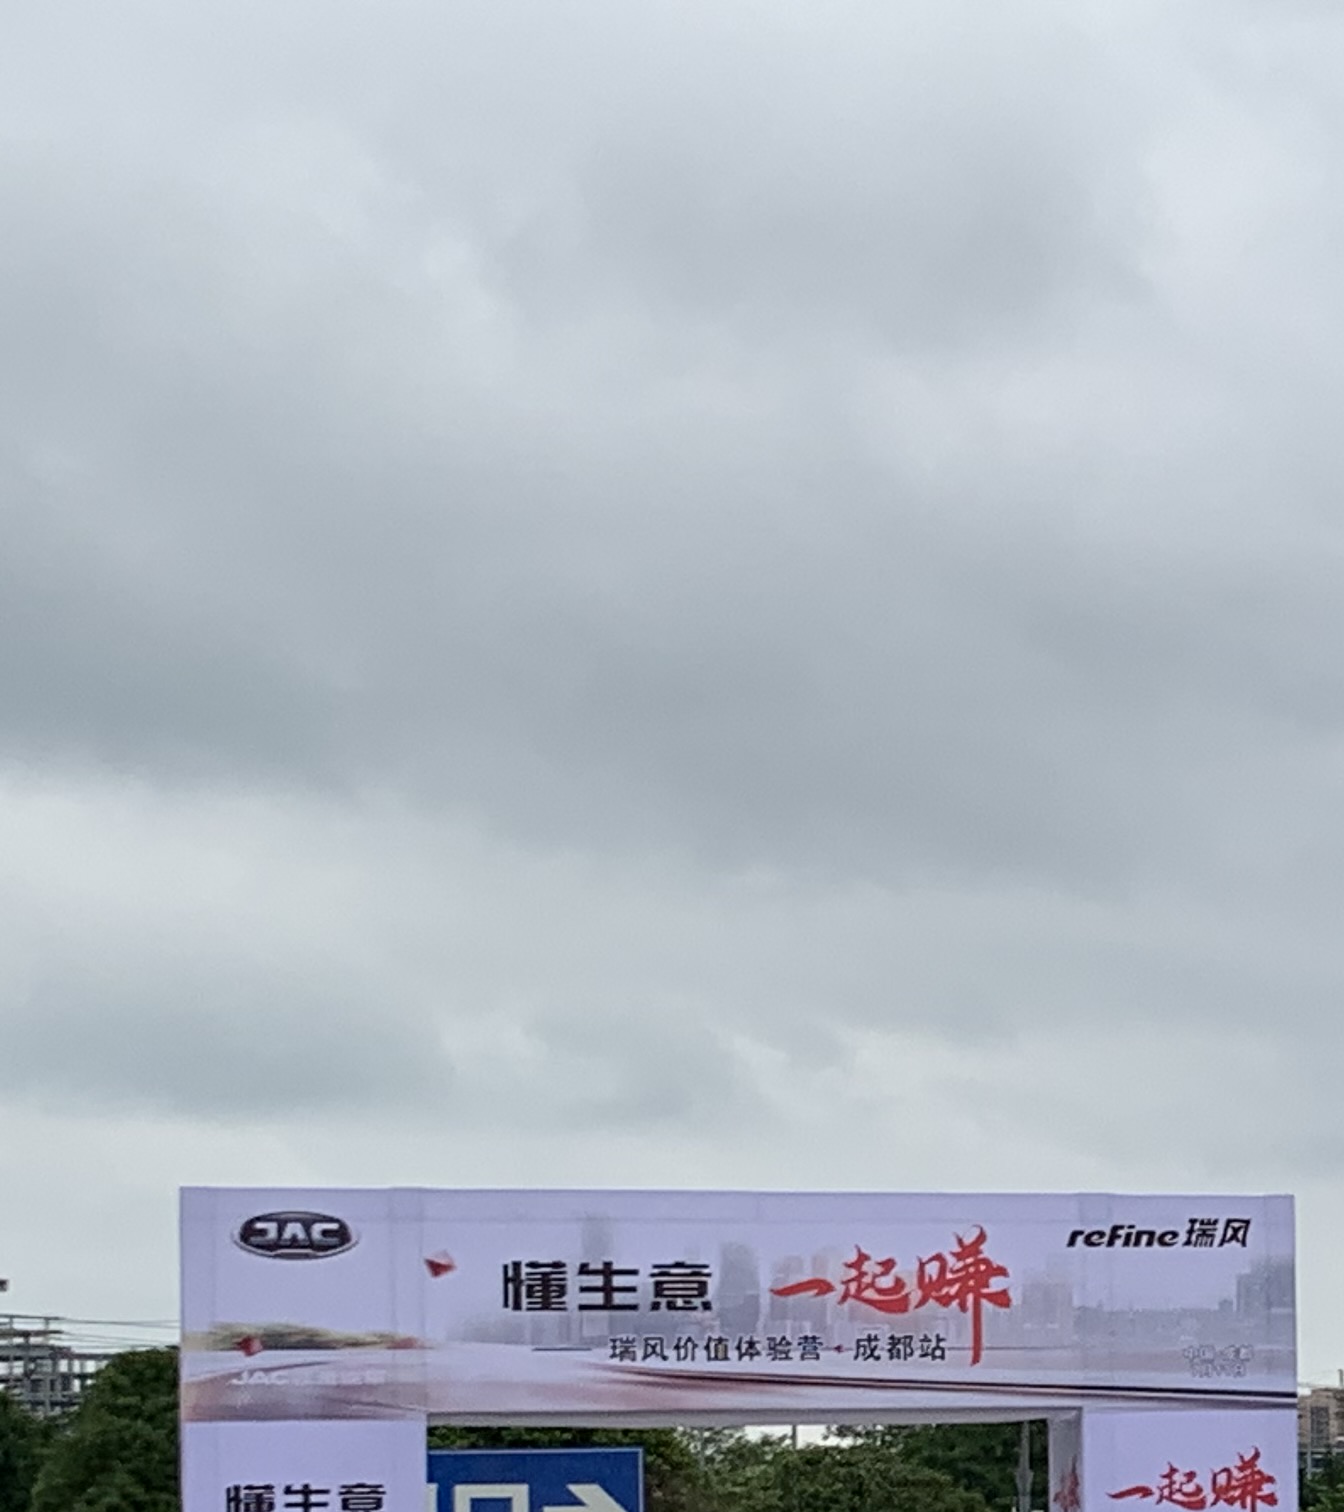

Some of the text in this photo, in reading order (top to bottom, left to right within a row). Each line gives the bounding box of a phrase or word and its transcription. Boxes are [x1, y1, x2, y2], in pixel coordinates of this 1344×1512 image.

[250, 1222, 340, 1245] JAC
[502, 1225, 1011, 1366] 懂生意 一起赚
